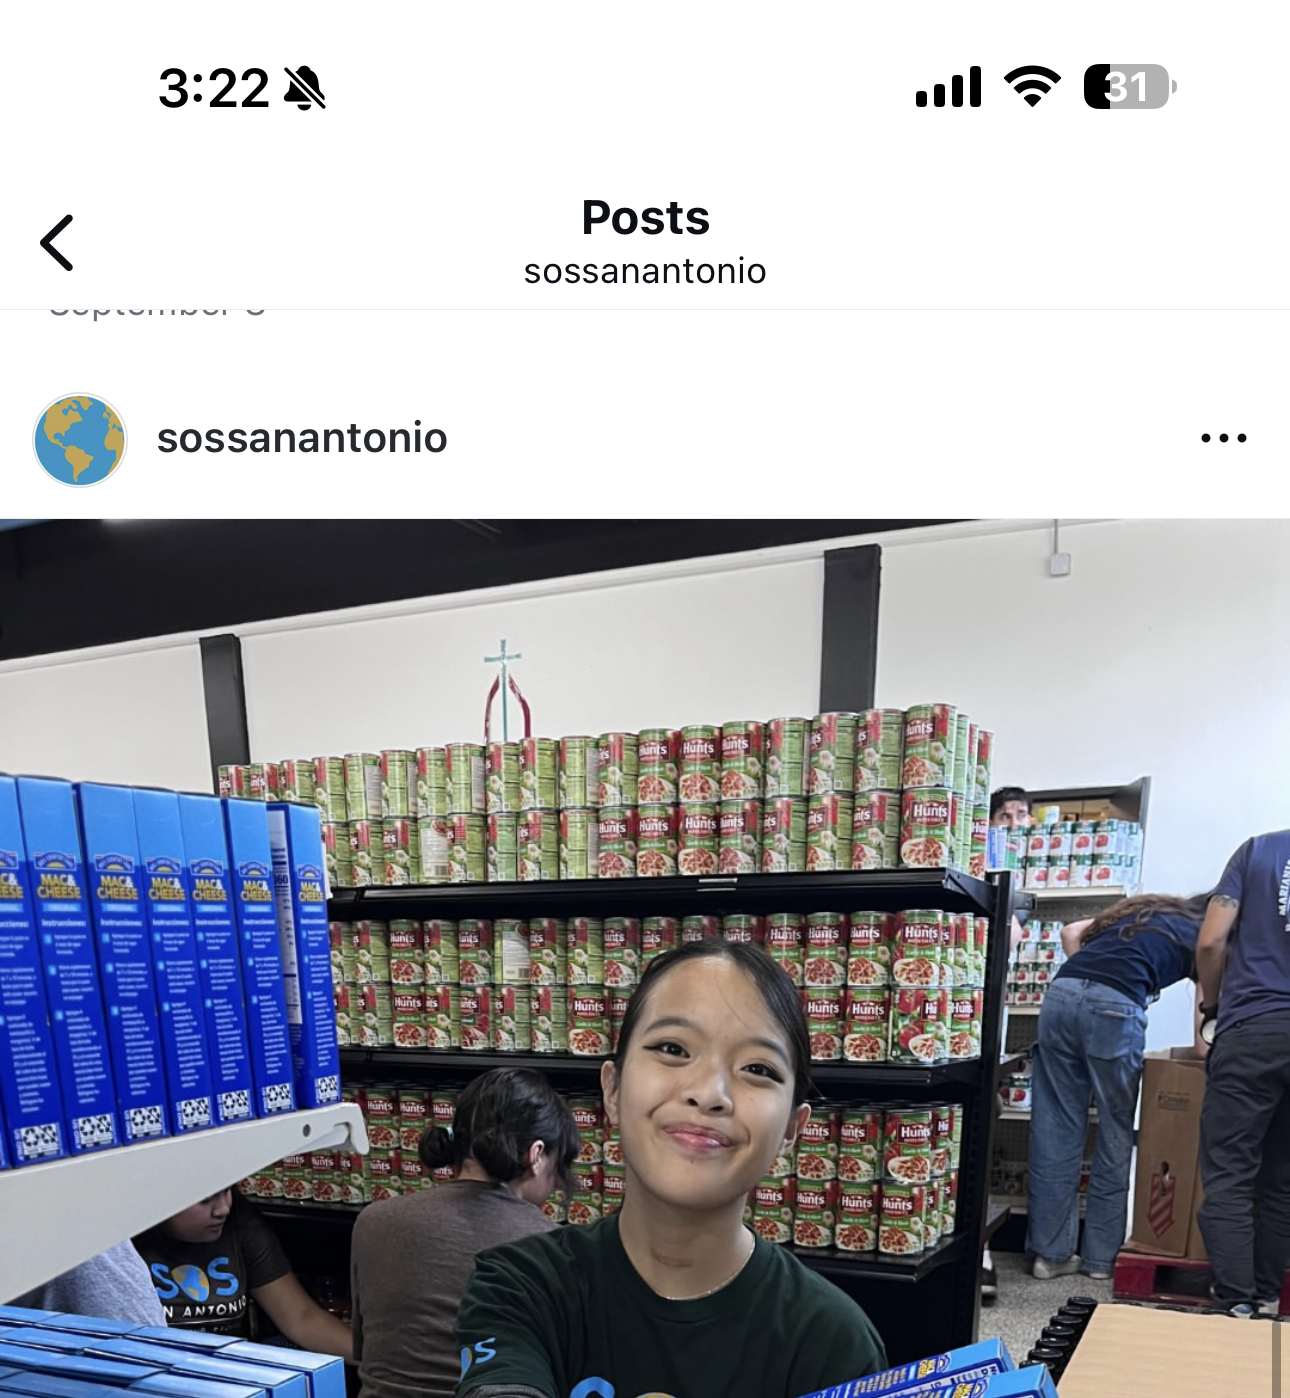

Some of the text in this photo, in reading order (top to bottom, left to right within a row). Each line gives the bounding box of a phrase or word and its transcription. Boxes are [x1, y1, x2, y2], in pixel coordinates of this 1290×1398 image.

[37, 886, 82, 900] CHEESE
[97, 886, 139, 900] CHEESE
[149, 888, 185, 901] CHEESE
[193, 889, 227, 901] CHEESE
[240, 890, 272, 901] CHEESE
[299, 891, 324, 901] CHEESE
[183, 1295, 247, 1317] ANTONIO
